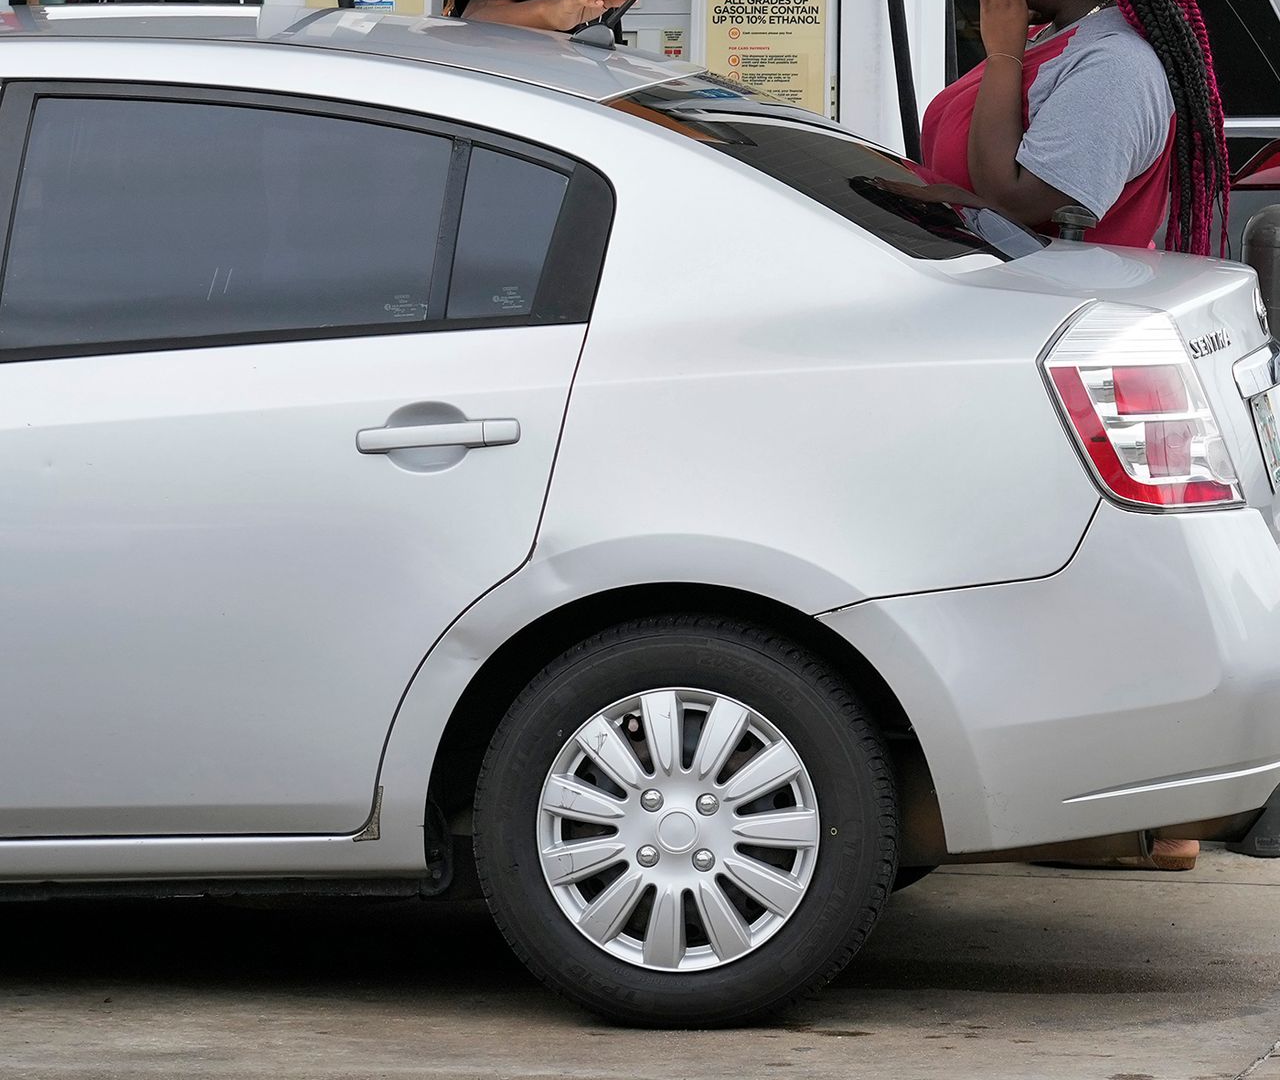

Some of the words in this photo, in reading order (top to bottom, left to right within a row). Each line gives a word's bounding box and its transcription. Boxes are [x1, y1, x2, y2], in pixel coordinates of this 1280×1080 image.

[714, 6, 768, 15] GASOLINE
[770, 6, 819, 15] CONTAIN
[712, 15, 727, 24] UP
[729, 15, 743, 24] TO
[747, 15, 766, 24] 10%
[769, 15, 820, 24] ETHANOL
